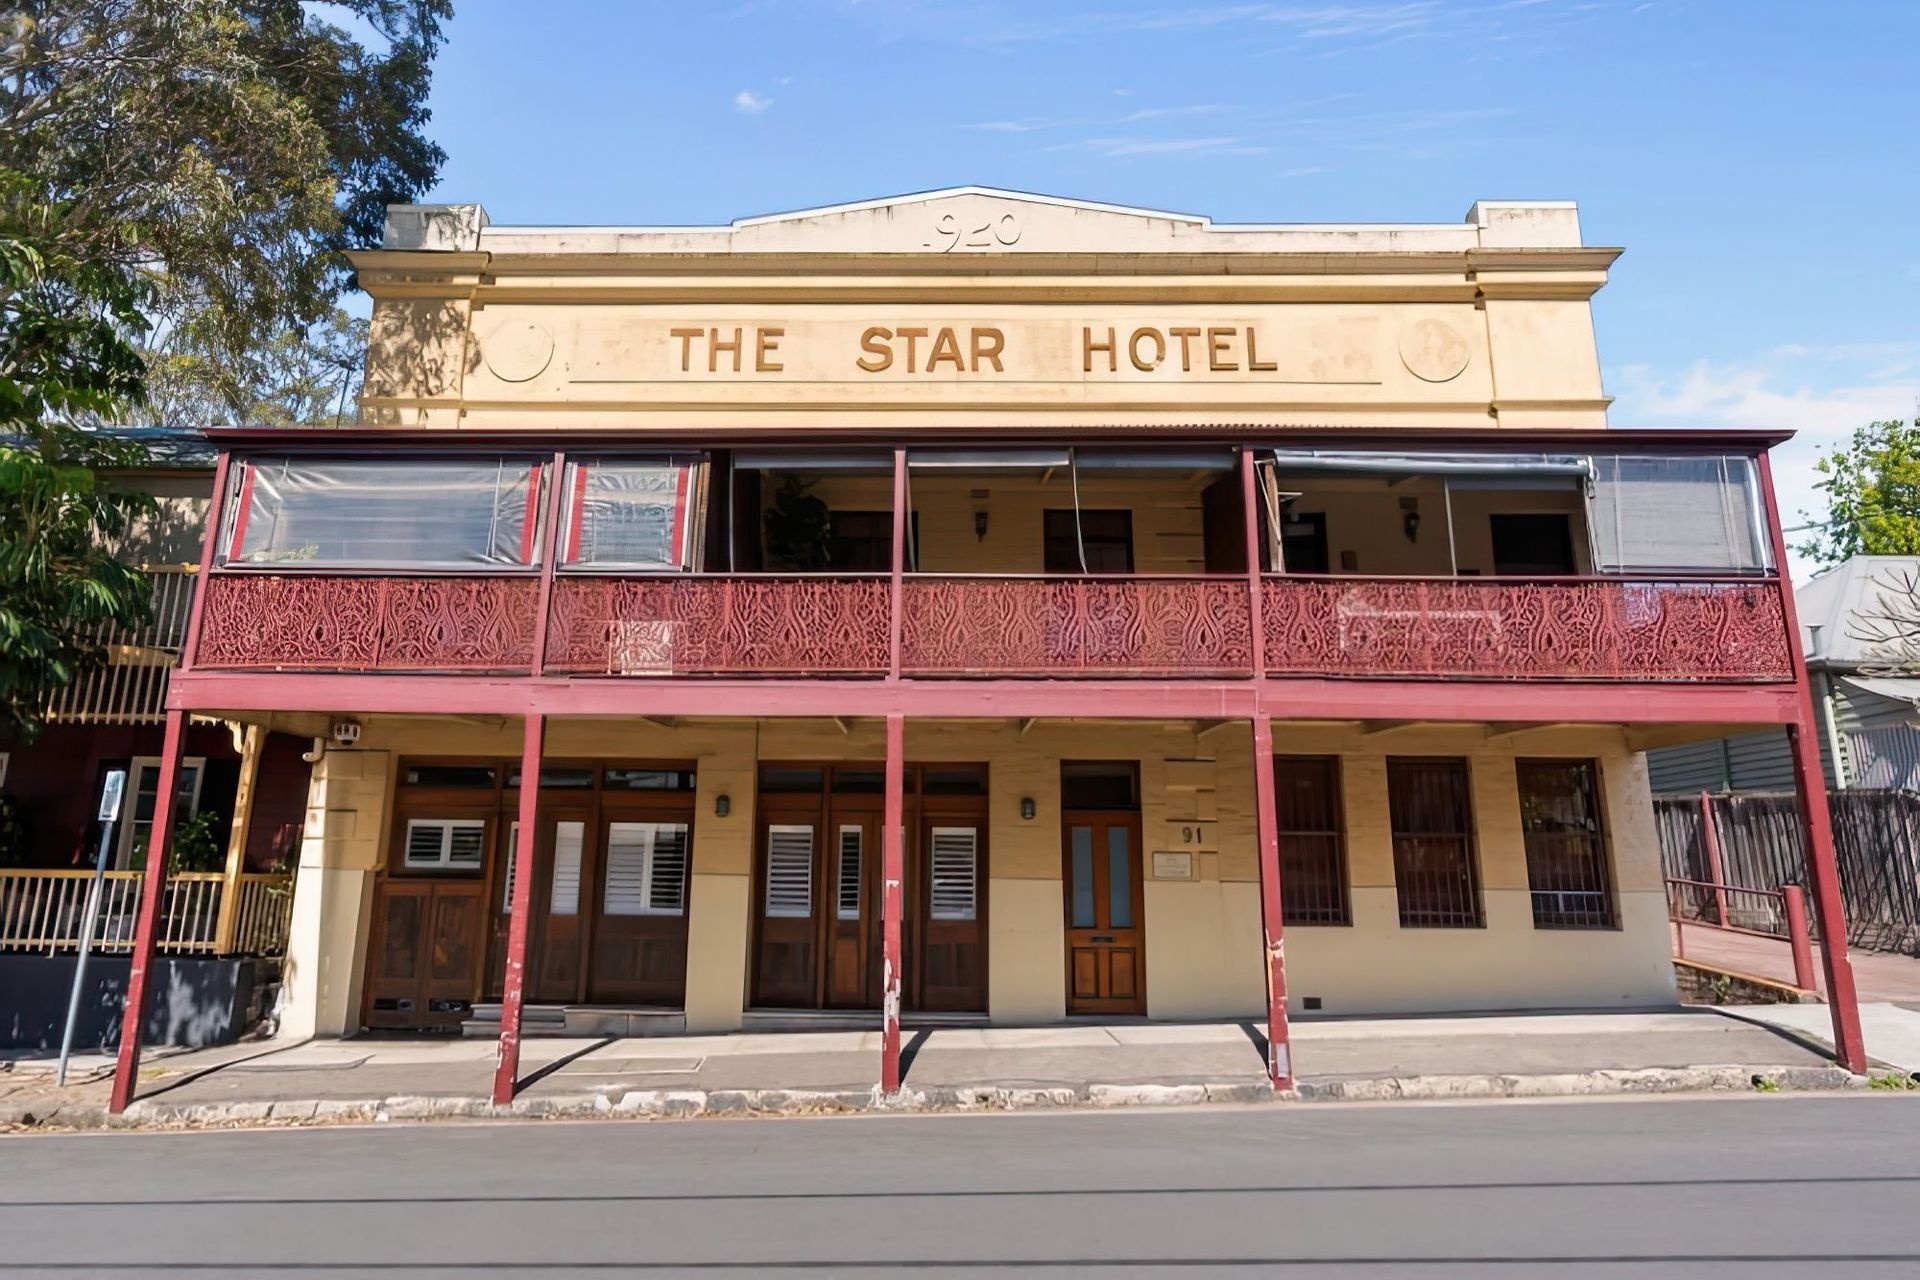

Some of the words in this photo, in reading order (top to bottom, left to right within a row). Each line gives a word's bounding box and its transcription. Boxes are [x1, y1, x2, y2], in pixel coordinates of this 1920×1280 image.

[670, 328, 785, 372] THE
[856, 327, 1006, 373] STAR
[1084, 327, 1278, 372] HOTEL
[1182, 826, 1202, 844] 91
